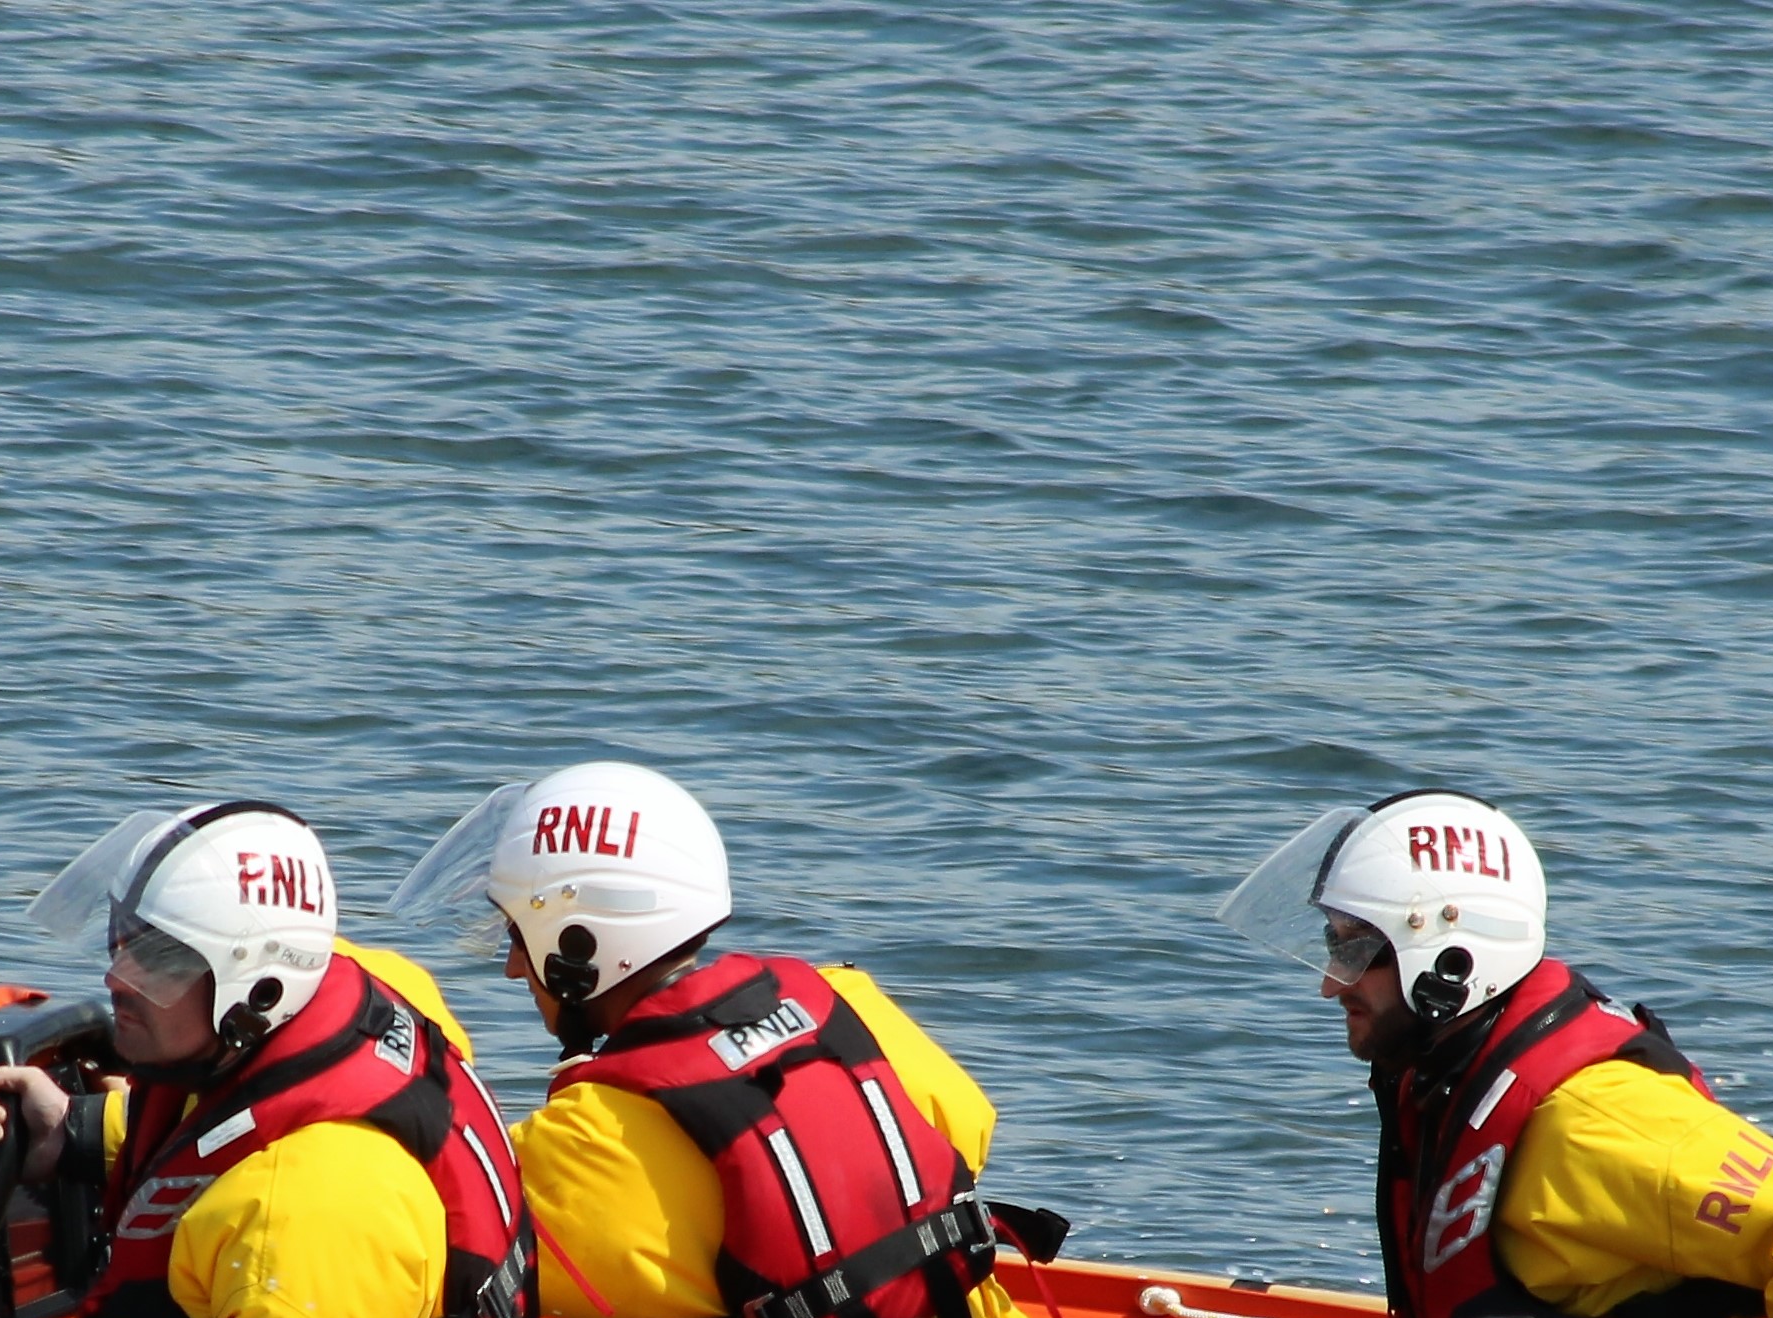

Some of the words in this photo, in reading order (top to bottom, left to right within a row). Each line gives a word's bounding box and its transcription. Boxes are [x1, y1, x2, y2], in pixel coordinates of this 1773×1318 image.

[531, 805, 641, 859] RNLI
[1408, 825, 1511, 882] RNLI
[236, 851, 324, 917] RNLI
[383, 1010, 413, 1060] RNL
[726, 1003, 805, 1058] RNLI
